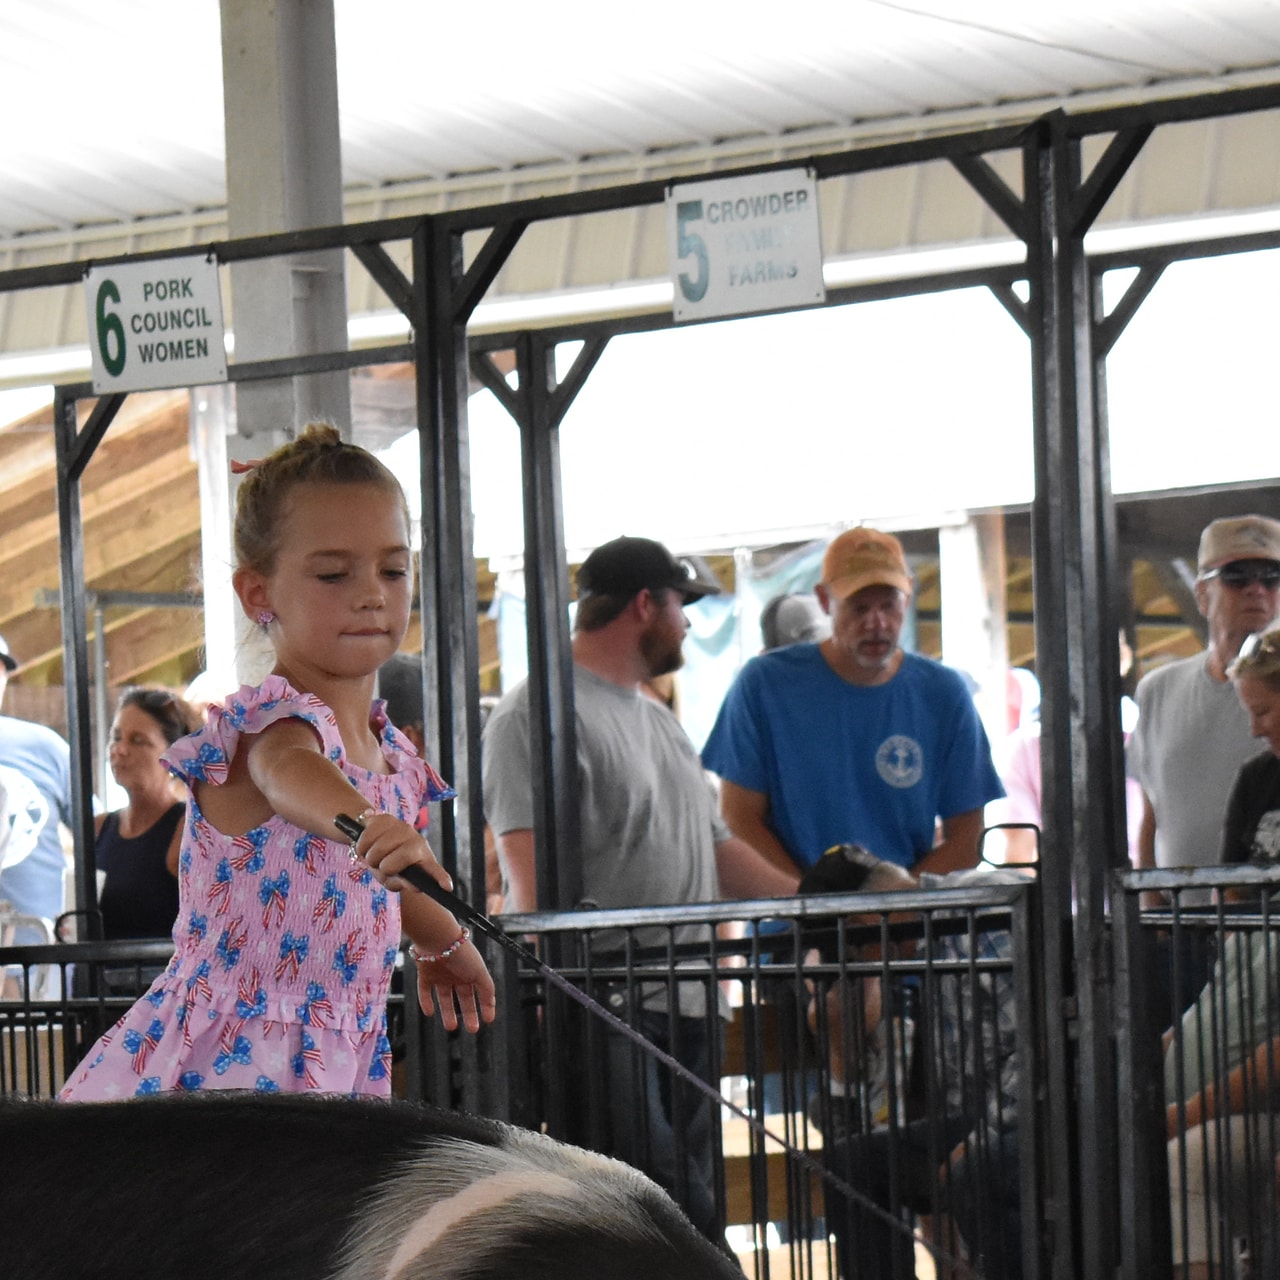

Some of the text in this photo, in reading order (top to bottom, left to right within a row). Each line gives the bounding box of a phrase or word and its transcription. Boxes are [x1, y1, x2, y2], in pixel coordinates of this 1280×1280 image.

[707, 189, 808, 224] CROWDER
[677, 199, 710, 303] 5
[728, 260, 798, 287] FARMS
[143, 278, 194, 302] PORK
[96, 279, 126, 378] 6
[131, 307, 212, 334] COUNCIL
[138, 338, 208, 364] WOMEN
